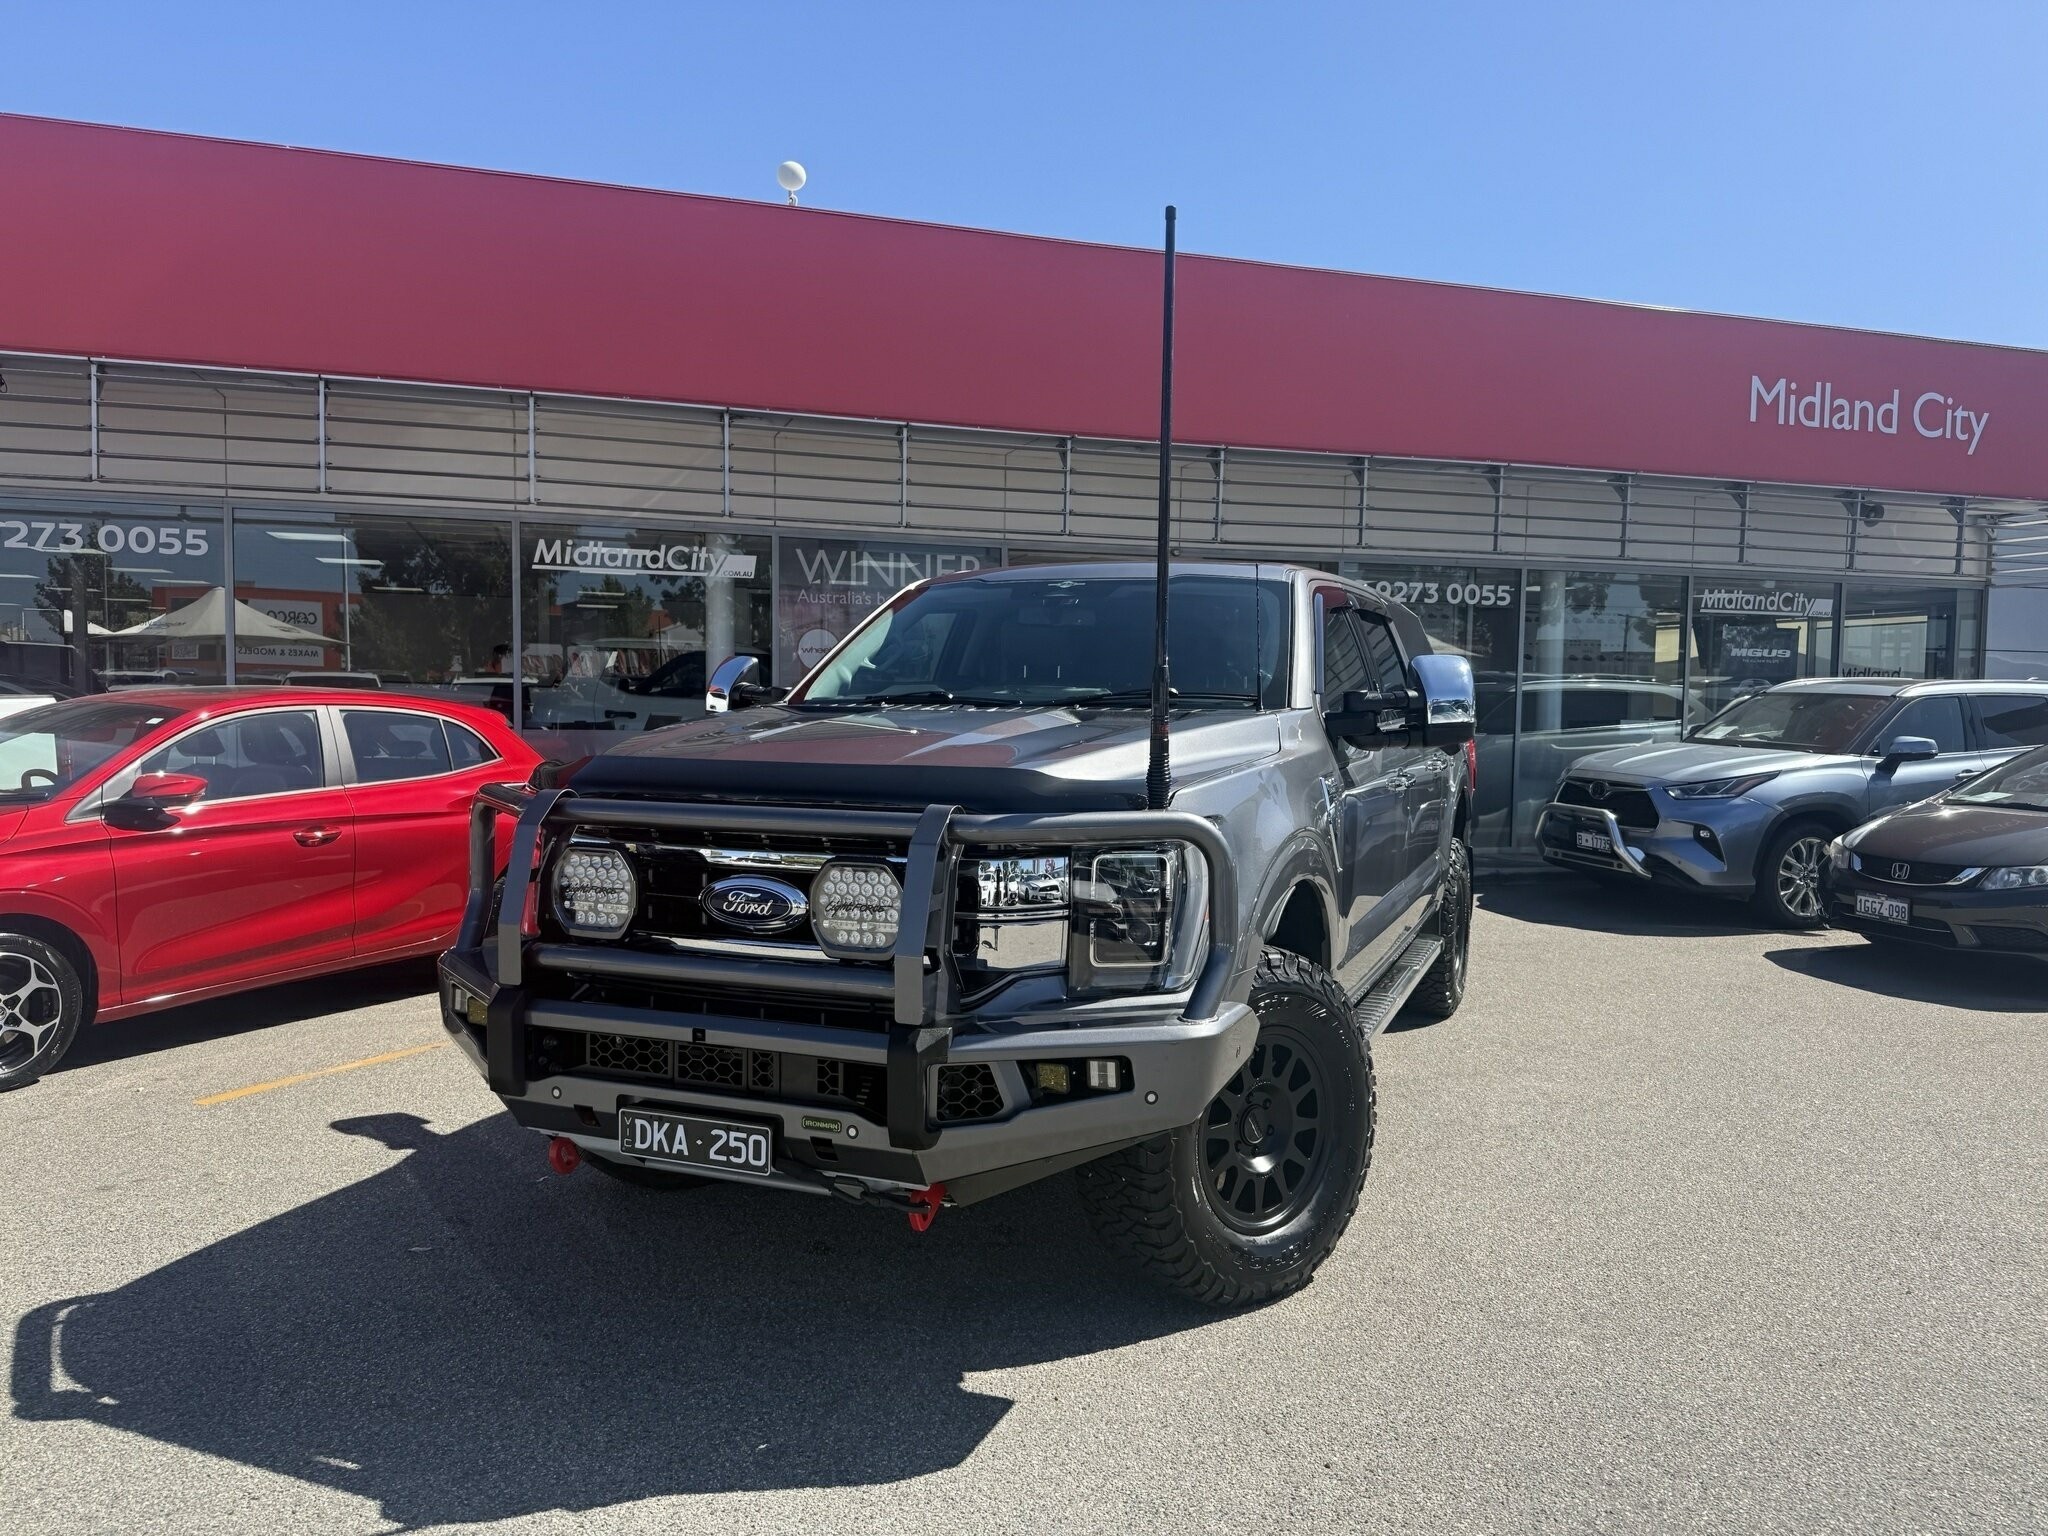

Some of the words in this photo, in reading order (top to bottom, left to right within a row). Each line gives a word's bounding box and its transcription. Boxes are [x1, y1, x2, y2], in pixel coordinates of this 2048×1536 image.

[1750, 375, 1899, 434] Midland
[1913, 392, 1989, 455] City
[98, 525, 209, 556] 0055
[533, 538, 728, 577] MidlandCity
[797, 591, 872, 606] Australia's
[1376, 581, 1439, 604] 9273
[1446, 583, 1511, 606] 0055
[1730, 648, 1791, 658] MGU9
[723, 890, 772, 916] Ford
[1888, 904, 1907, 919] 098
[805, 1119, 838, 1130] IRONMAN
[634, 1118, 689, 1156] DKA
[709, 1128, 767, 1168] 250
